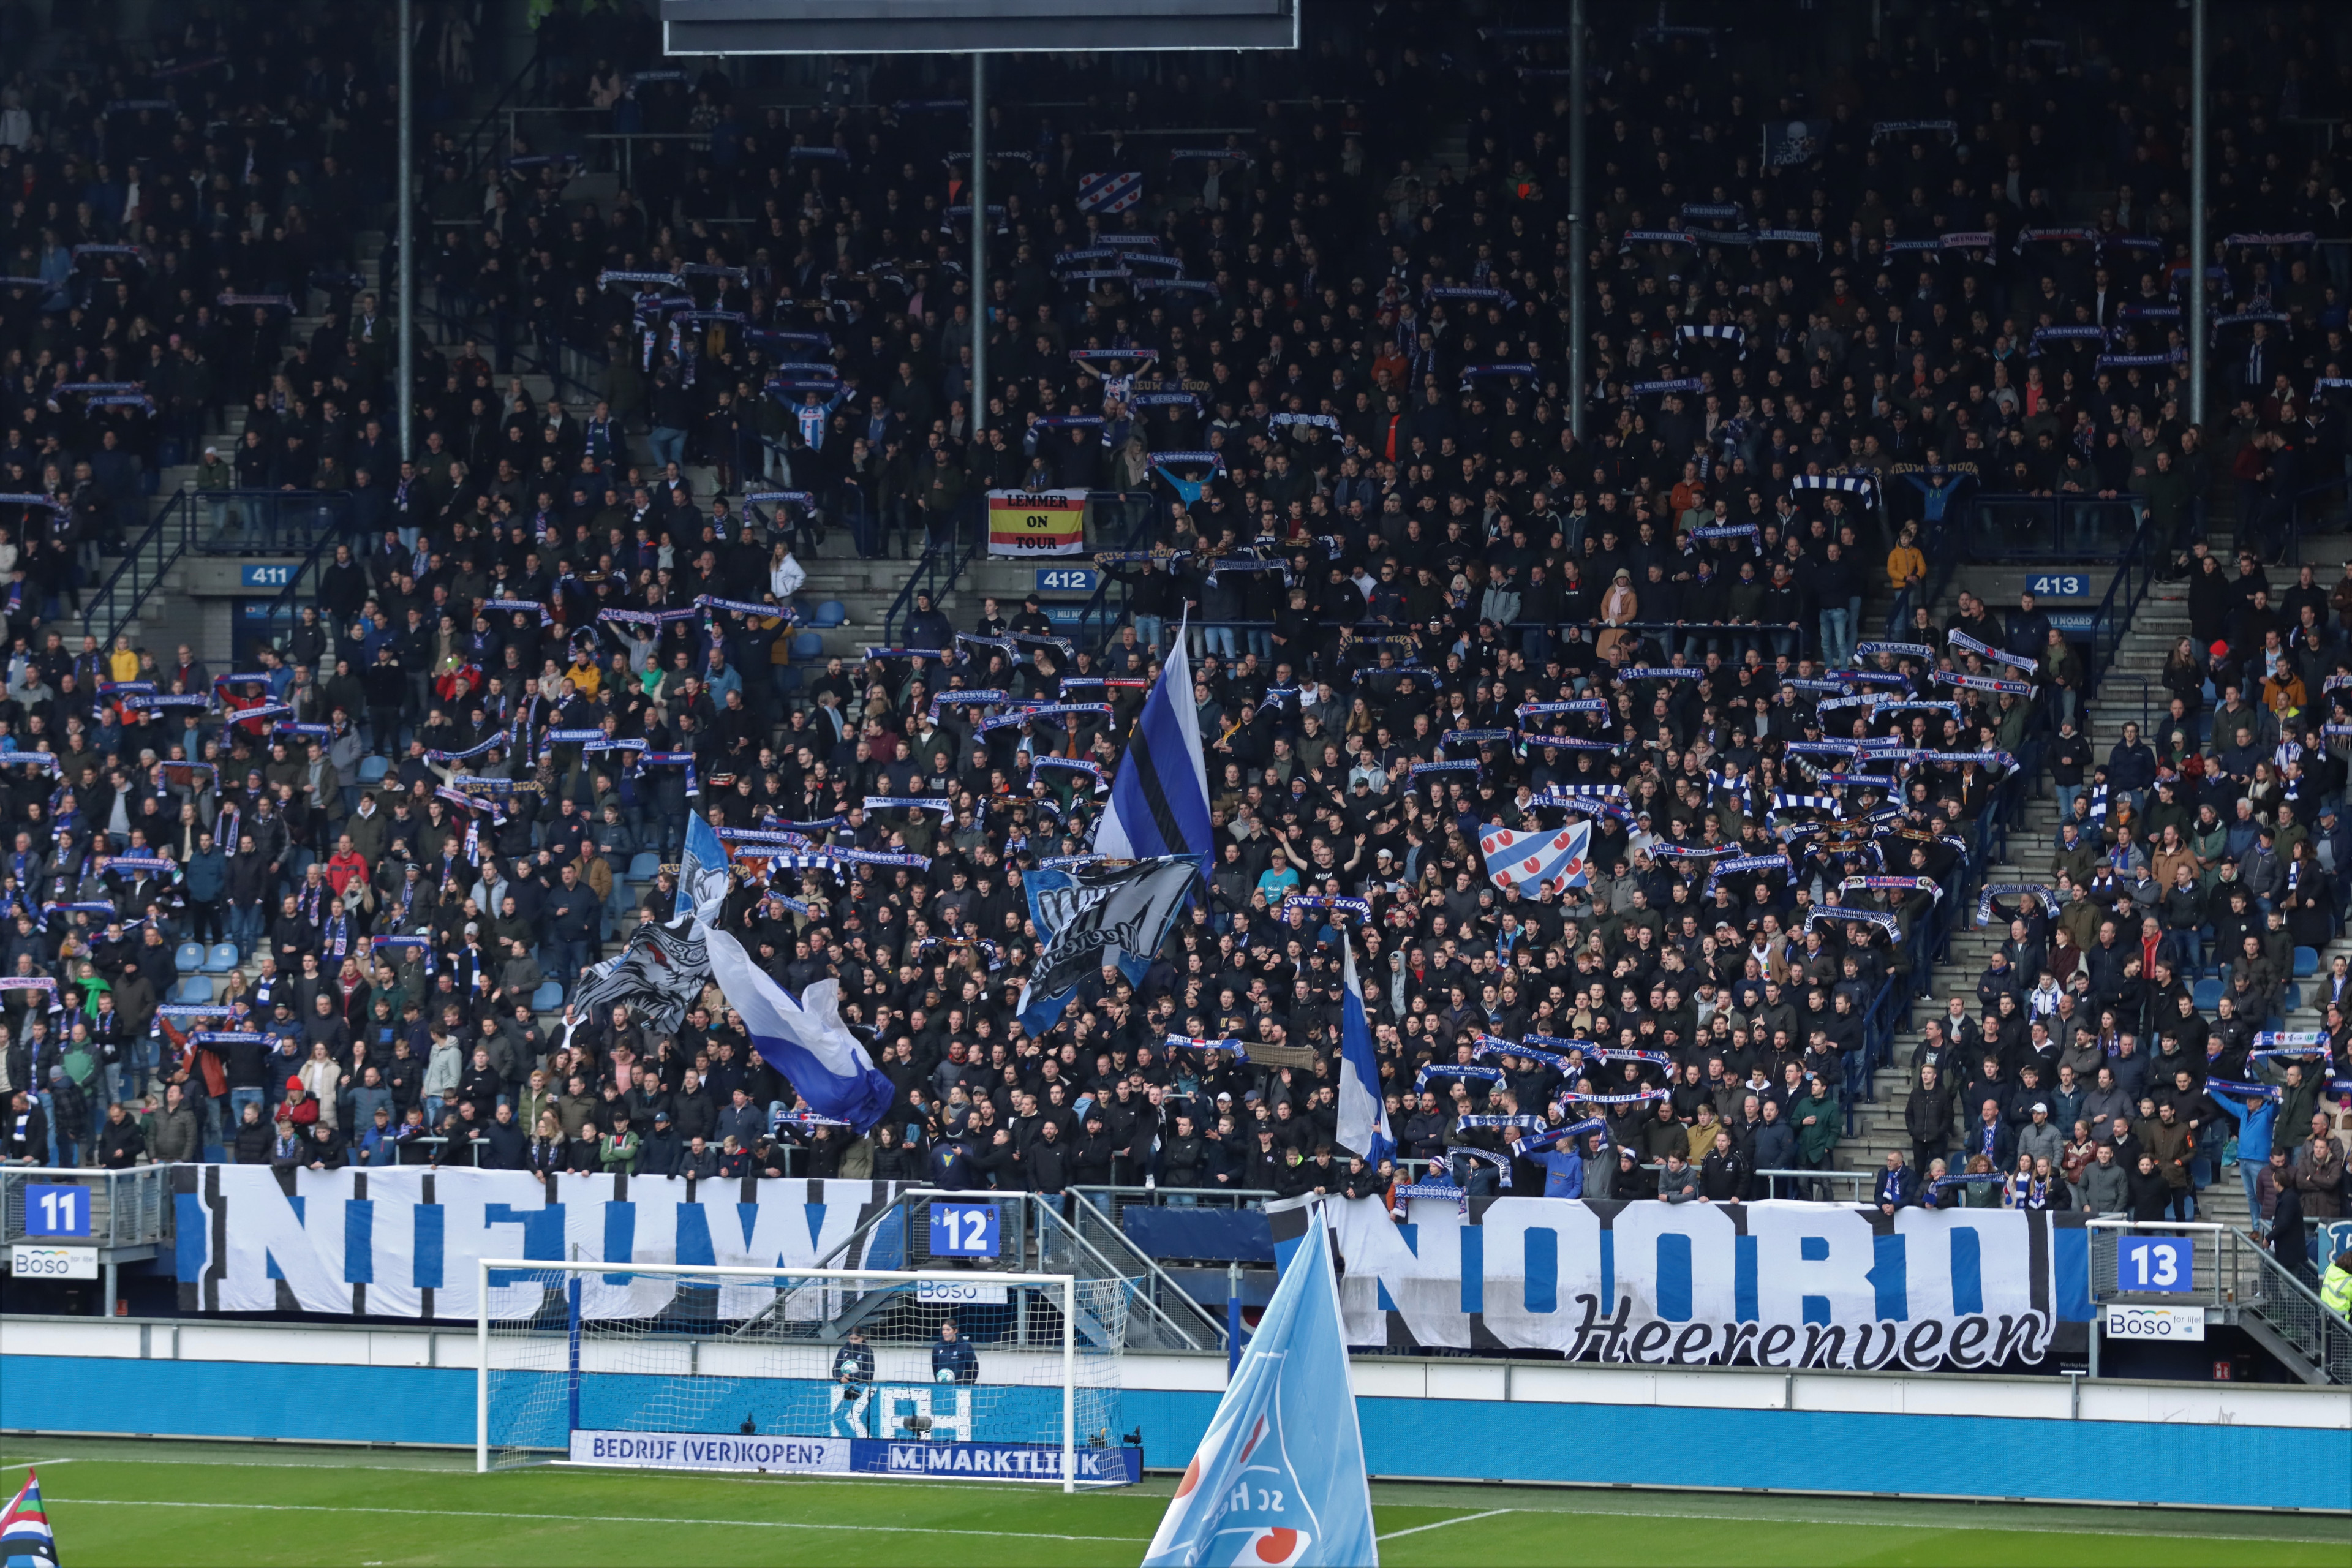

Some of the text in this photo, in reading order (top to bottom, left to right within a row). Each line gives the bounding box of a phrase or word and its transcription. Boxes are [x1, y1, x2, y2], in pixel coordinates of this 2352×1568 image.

[1644, 380, 1687, 390] HEERENVEEN
[1165, 453, 1215, 462] HEERENVEEN
[1007, 493, 1069, 509] LEMMER
[1026, 516, 1048, 529] ON
[1015, 537, 1057, 551] TOUR
[252, 567, 287, 584] 411
[1043, 571, 1086, 588] 412
[2034, 576, 2079, 594] 413
[726, 600, 779, 614] HEERENVEEN
[2061, 617, 2092, 625] NOARD
[1857, 673, 1902, 682] HEERENVEEN
[1967, 679, 1993, 690] WHITE
[2002, 682, 2027, 693] ARMY
[941, 691, 1000, 701] HEERENVEEN
[1047, 703, 1101, 712] HEERENVEEN
[1545, 701, 1598, 712] HEERENVEEN
[562, 729, 604, 739] HEERENVEEN
[1417, 760, 1478, 770] HEERENVEEN
[1848, 775, 1887, 783] HEERENVEEN
[875, 796, 951, 807] HEERENVEEN
[1553, 797, 1595, 813] HEERENVEEN
[794, 816, 836, 826] HEERENVEEN
[734, 829, 788, 840] HEERENVEEN
[848, 849, 905, 862] HEERENVEEN
[1726, 857, 1785, 870] HEERENVEEN
[1335, 898, 1371, 922] NOORD
[1464, 1066, 1496, 1075] NOORD
[1586, 1093, 1636, 1102] HEERENVEEN
[1477, 1115, 1525, 1126] BOYS
[1562, 1118, 1603, 1136] HEERENVEEN
[1408, 1187, 1462, 1197] HEERENVEEN
[40, 1191, 75, 1231] 11
[943, 1210, 987, 1251] 12
[217, 1165, 871, 1321] NIEUW
[16, 1254, 69, 1274] Boso
[2131, 1243, 2178, 1286] 13
[1326, 1192, 2034, 1351] NOORD
[919, 1280, 977, 1299] Boso
[2110, 1314, 2171, 1335] Boso
[1574, 1294, 2045, 1371] Heerenveen
[593, 1438, 825, 1465] BEDRIJF (VER)KOPEN?
